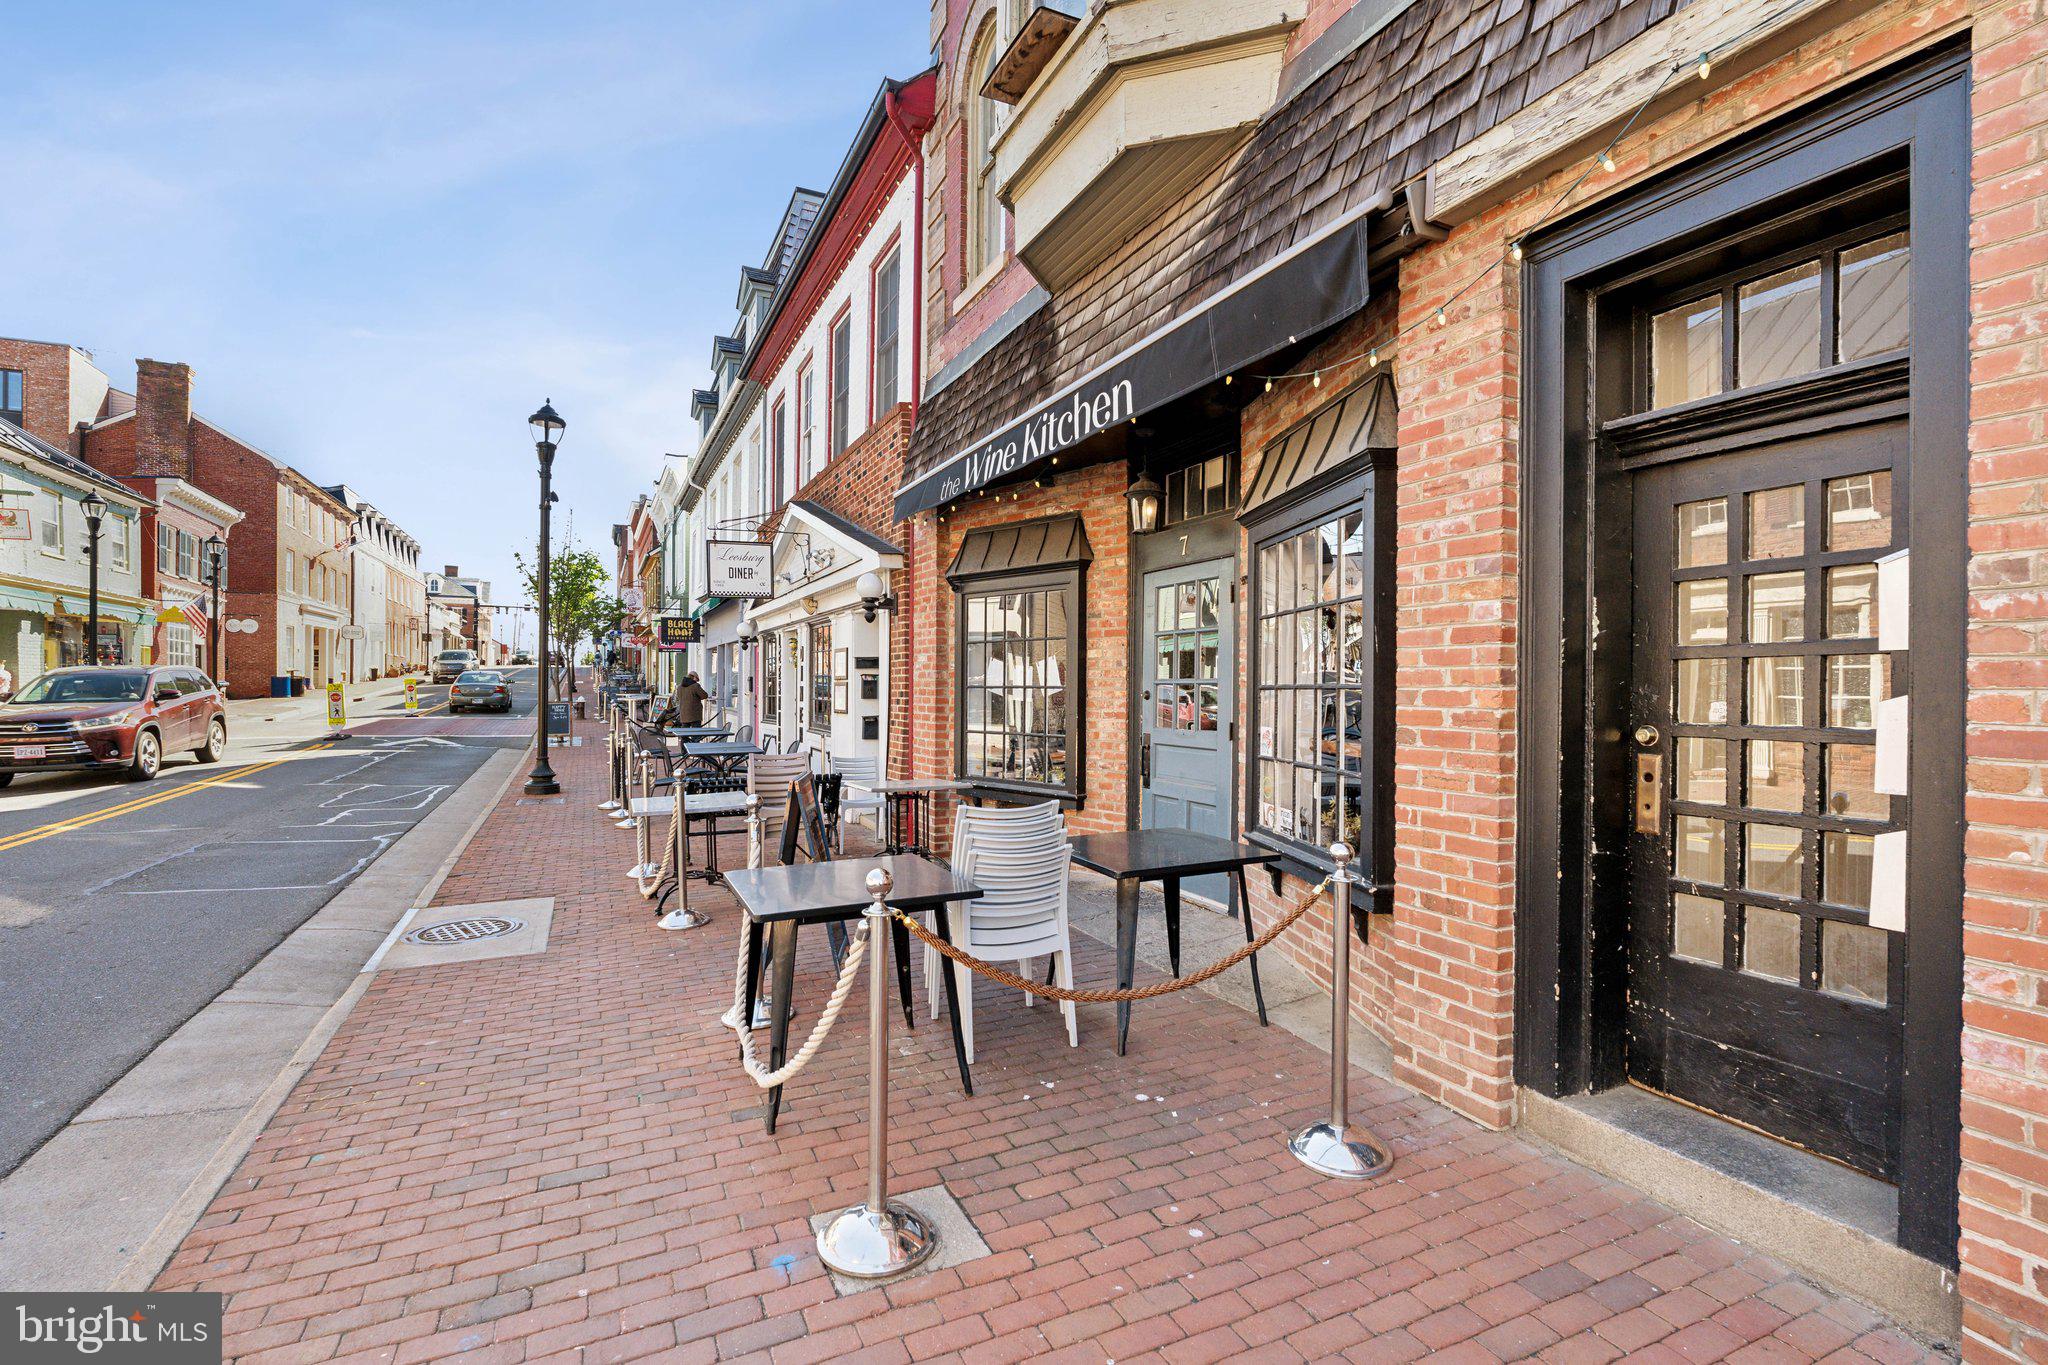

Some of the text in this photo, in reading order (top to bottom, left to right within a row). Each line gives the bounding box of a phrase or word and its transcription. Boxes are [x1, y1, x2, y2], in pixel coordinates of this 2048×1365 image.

[940, 379, 1133, 501] the Wine Kitchen
[1179, 534, 1189, 556] 7
[717, 546, 765, 567] Leesburg
[728, 566, 754, 580] DINER
[667, 619, 694, 629] BLACK
